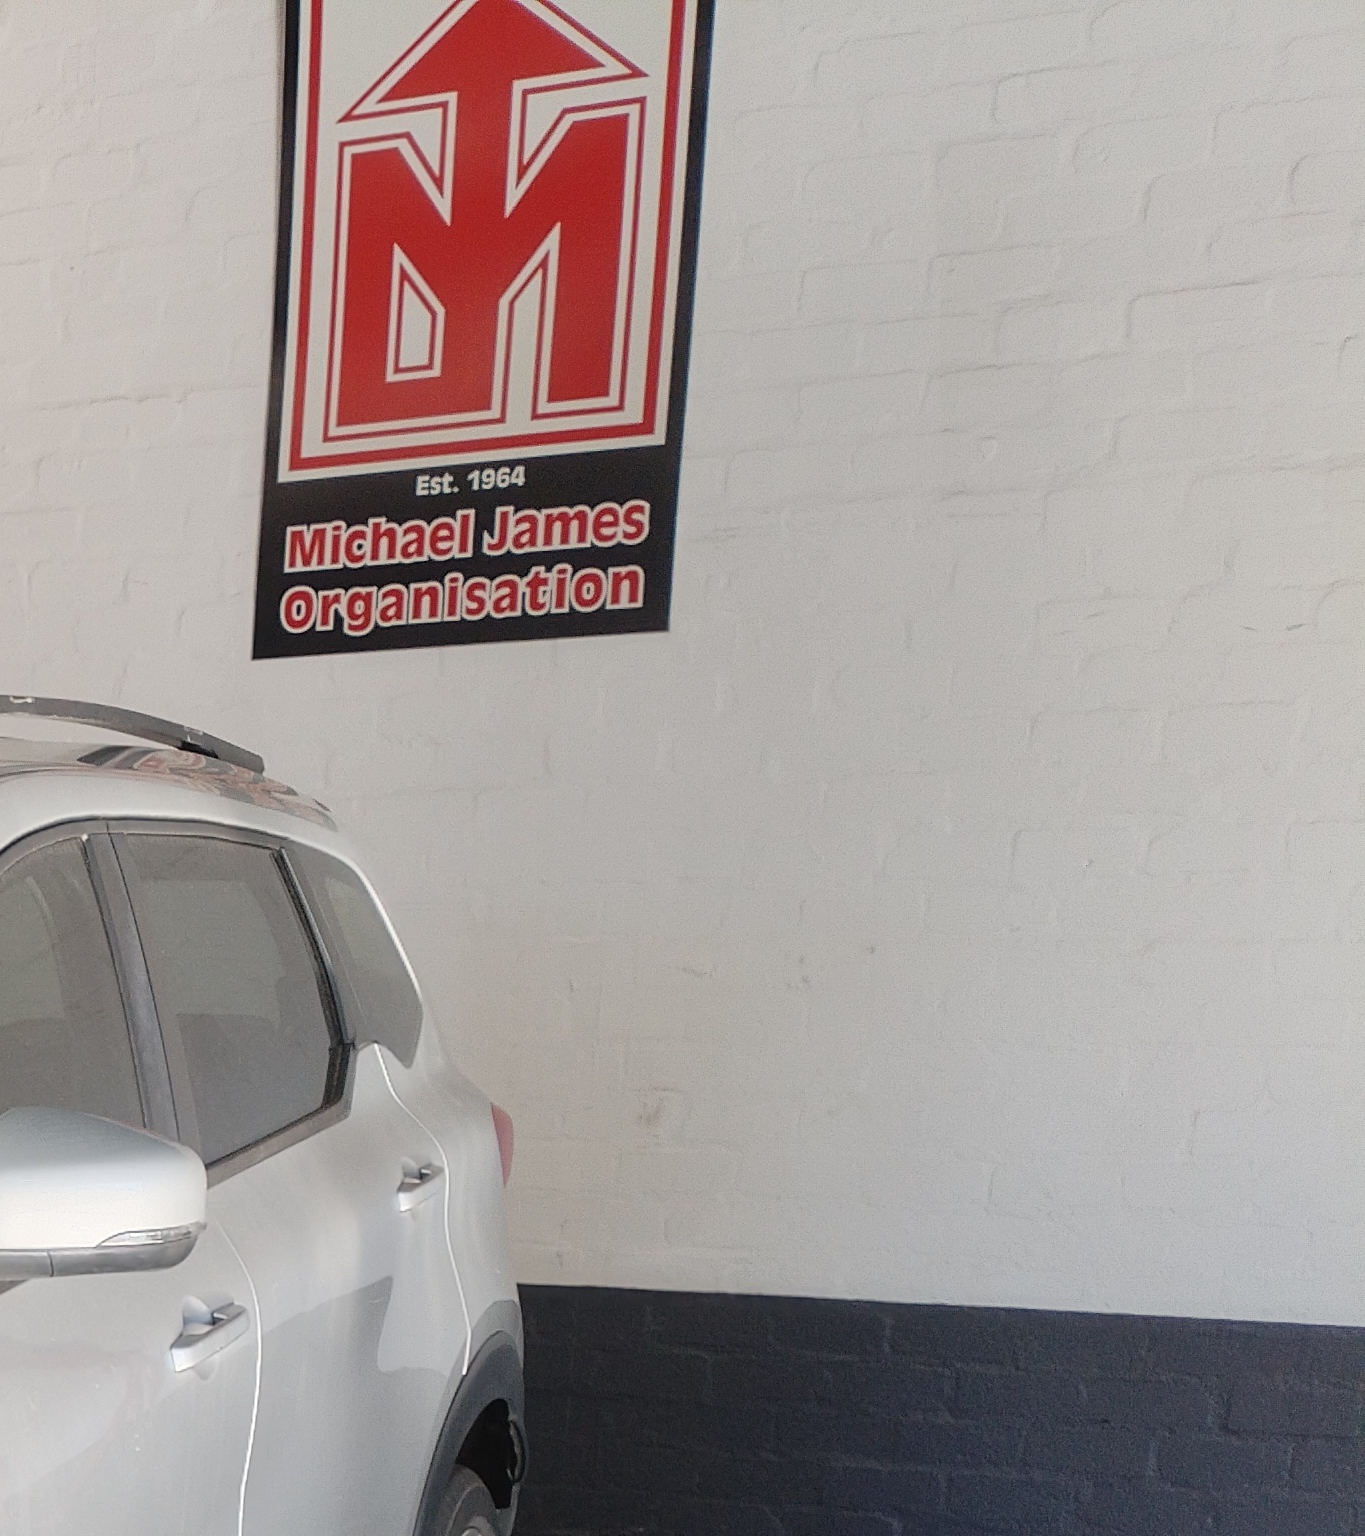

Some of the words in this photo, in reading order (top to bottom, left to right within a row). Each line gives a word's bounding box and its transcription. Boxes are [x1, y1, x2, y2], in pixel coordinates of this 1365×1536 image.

[416, 474, 460, 497] Est.
[468, 465, 526, 491] 1964
[284, 509, 474, 573] Michael
[482, 499, 650, 556] James
[280, 564, 645, 637] Organisation
